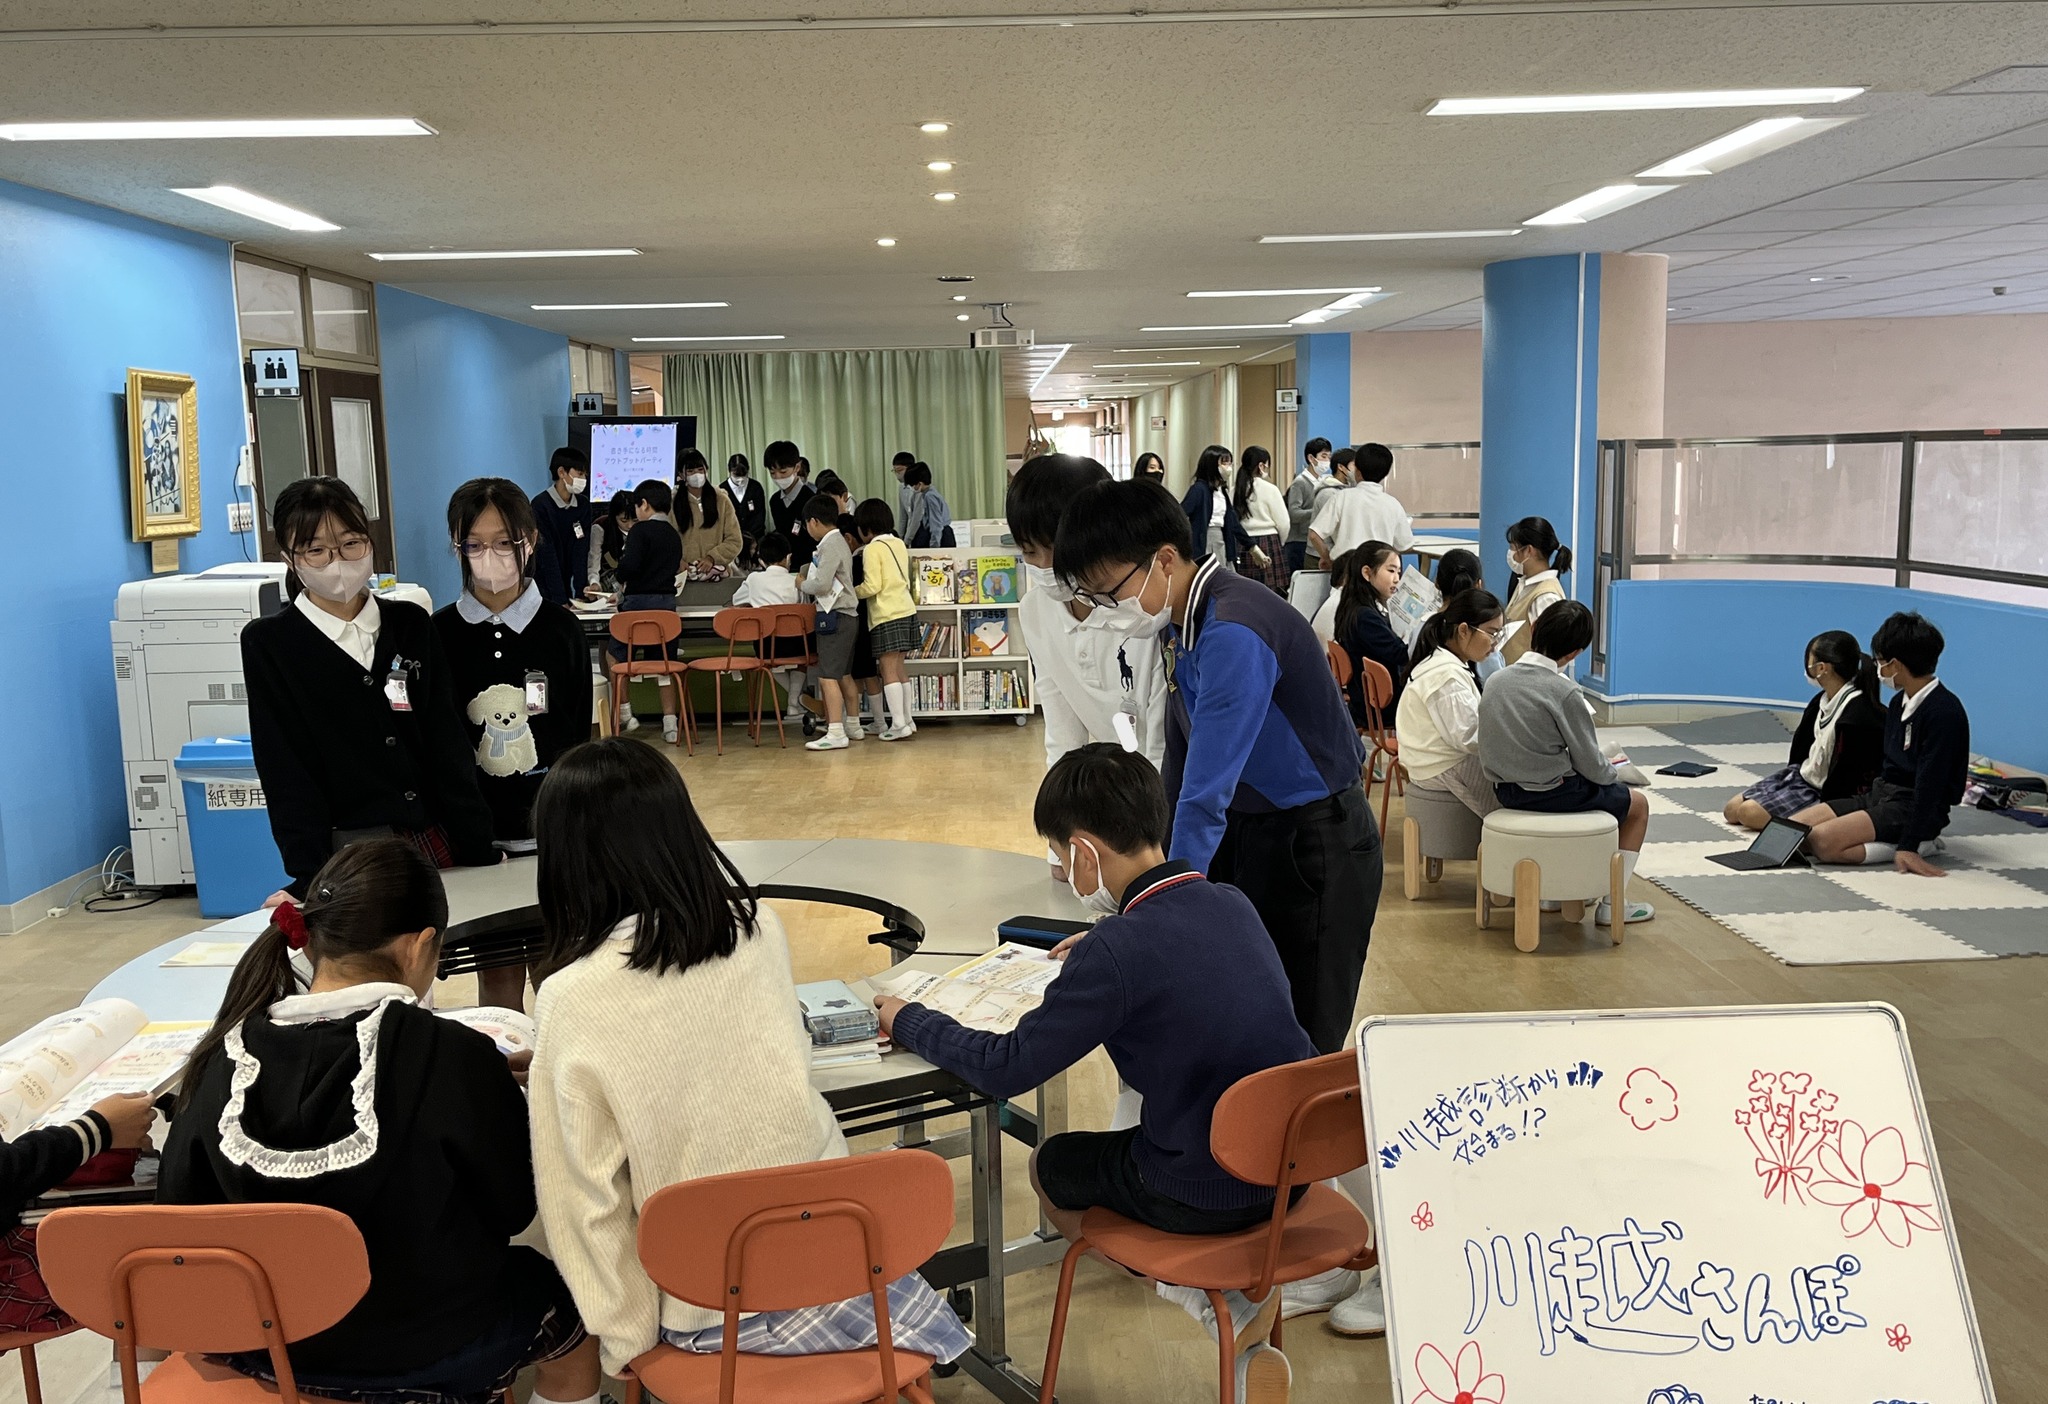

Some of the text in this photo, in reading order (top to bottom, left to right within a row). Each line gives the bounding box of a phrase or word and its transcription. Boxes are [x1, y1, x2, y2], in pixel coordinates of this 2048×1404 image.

[208, 788, 267, 808] 紙専用
[1398, 1069, 1559, 1151] 川越診断から
[1464, 1217, 1868, 1356] 川越さんぽ
